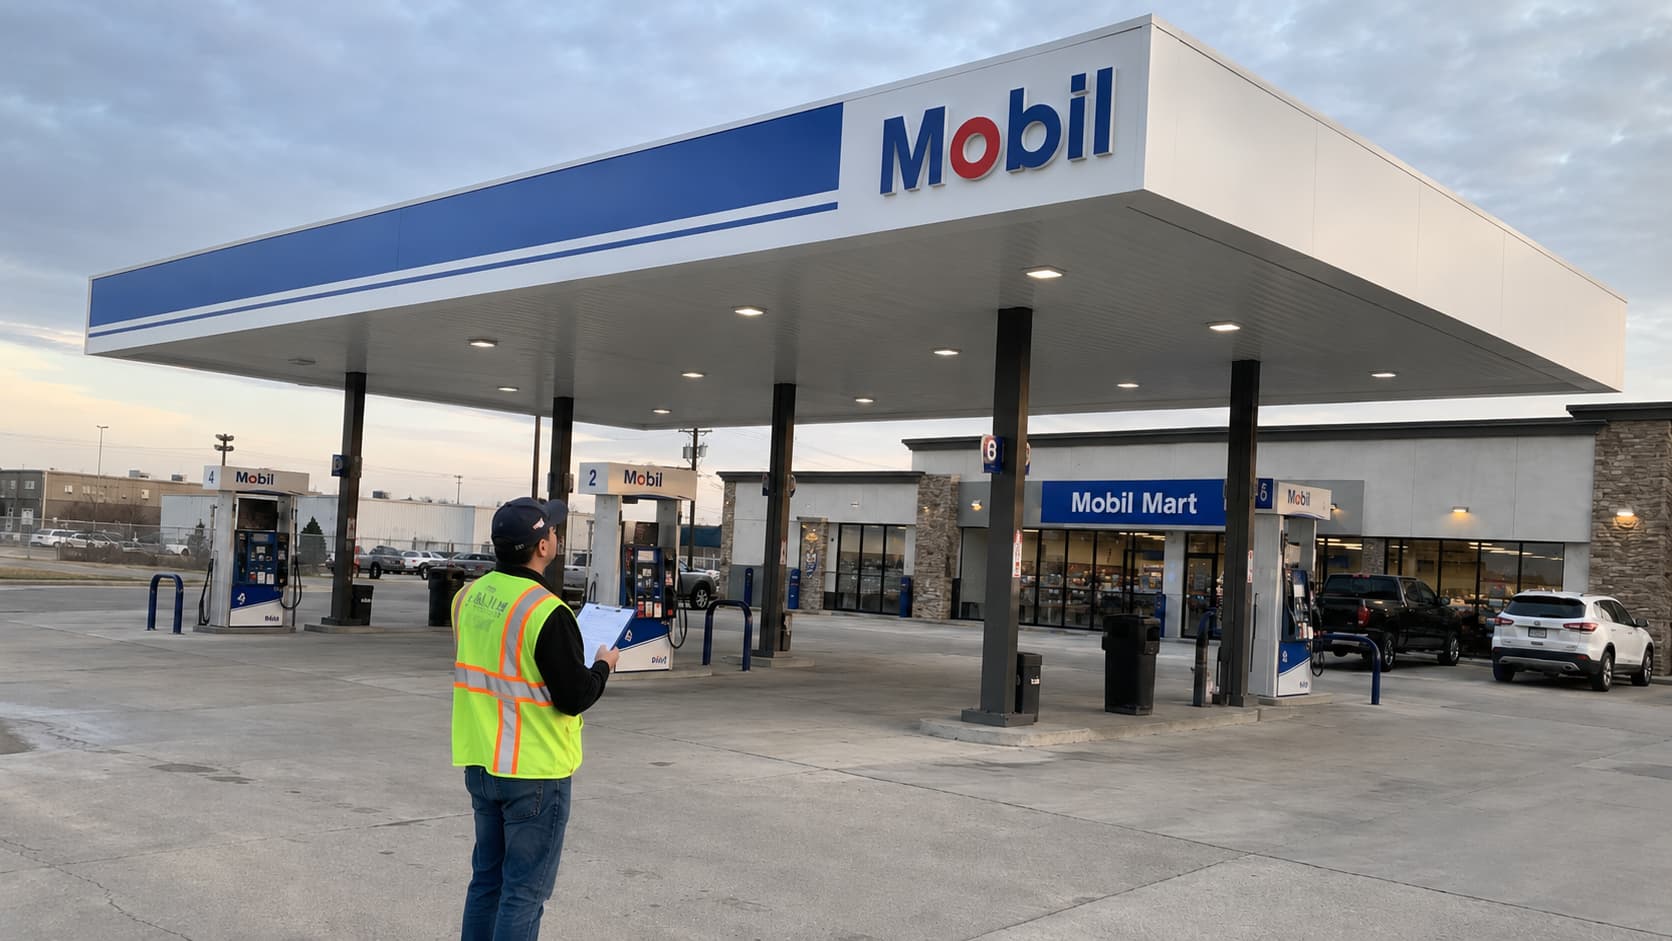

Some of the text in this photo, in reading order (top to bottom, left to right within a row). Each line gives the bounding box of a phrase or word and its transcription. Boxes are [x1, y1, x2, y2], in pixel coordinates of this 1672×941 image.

[880, 66, 1115, 196] Mobil
[208, 470, 215, 484] 4
[235, 471, 274, 485] Mobil
[588, 469, 597, 486] 2
[623, 469, 663, 487] Mobil
[1071, 491, 1198, 514] Mobil Mart
[1287, 488, 1311, 507] Mobil
